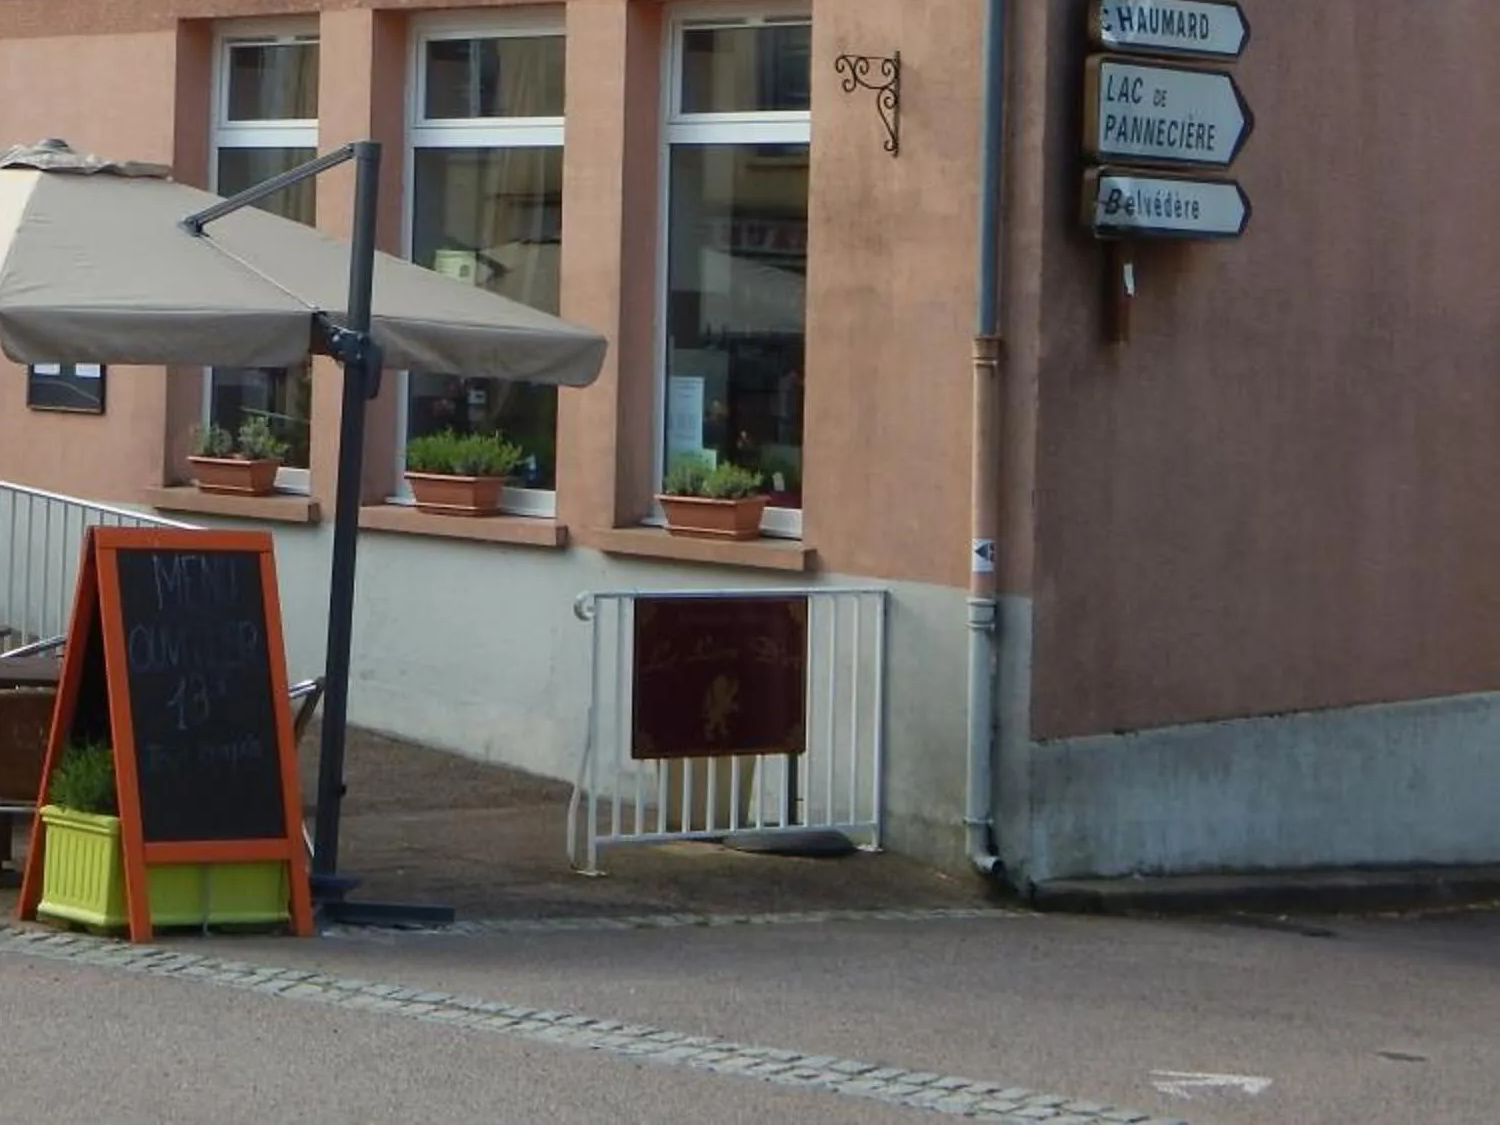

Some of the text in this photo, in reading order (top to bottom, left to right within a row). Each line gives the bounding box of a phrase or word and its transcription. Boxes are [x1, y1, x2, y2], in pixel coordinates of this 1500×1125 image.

[1105, 74, 1168, 108] LAC DE
[1104, 112, 1215, 152] PANNECIÈRE
[1104, 187, 1201, 221] Belvédère
